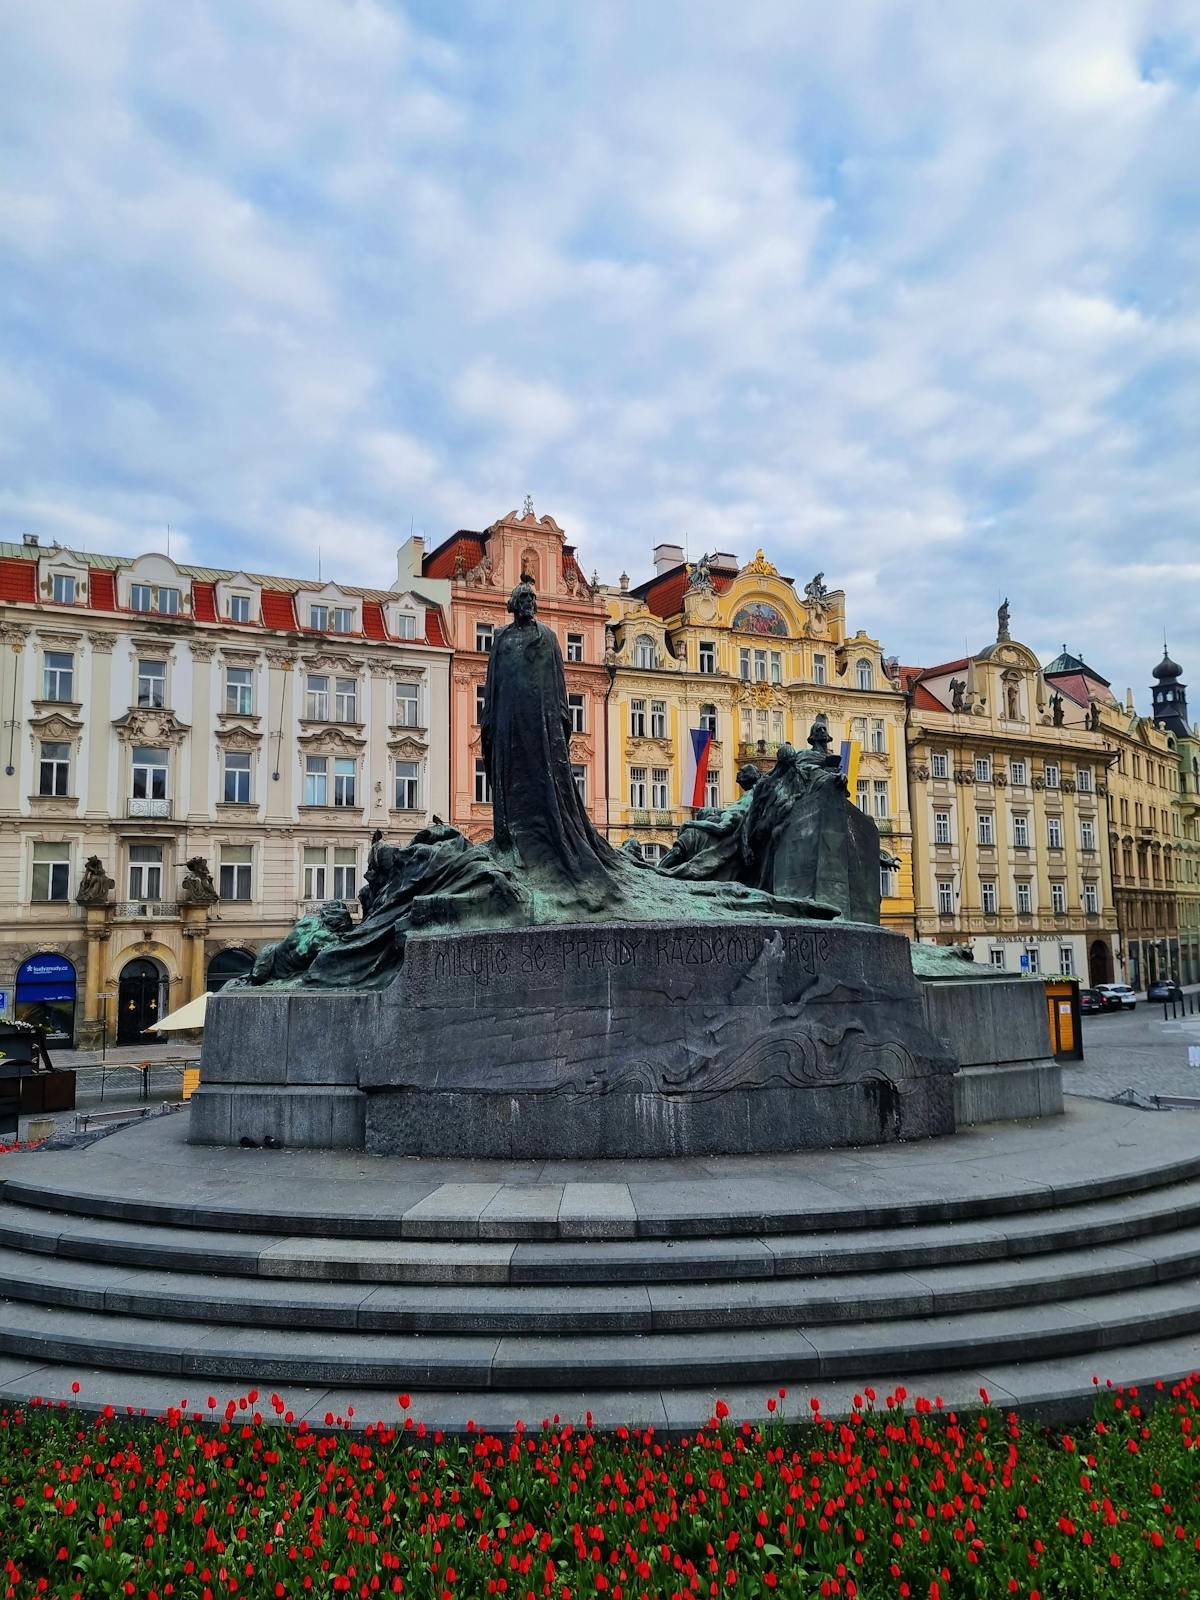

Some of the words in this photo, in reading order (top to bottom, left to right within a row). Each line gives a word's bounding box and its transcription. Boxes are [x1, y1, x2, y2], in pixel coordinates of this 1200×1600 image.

[434, 942, 509, 986] MILUJTE
[521, 944, 547, 973] SE
[562, 938, 642, 971] PRAVDY
